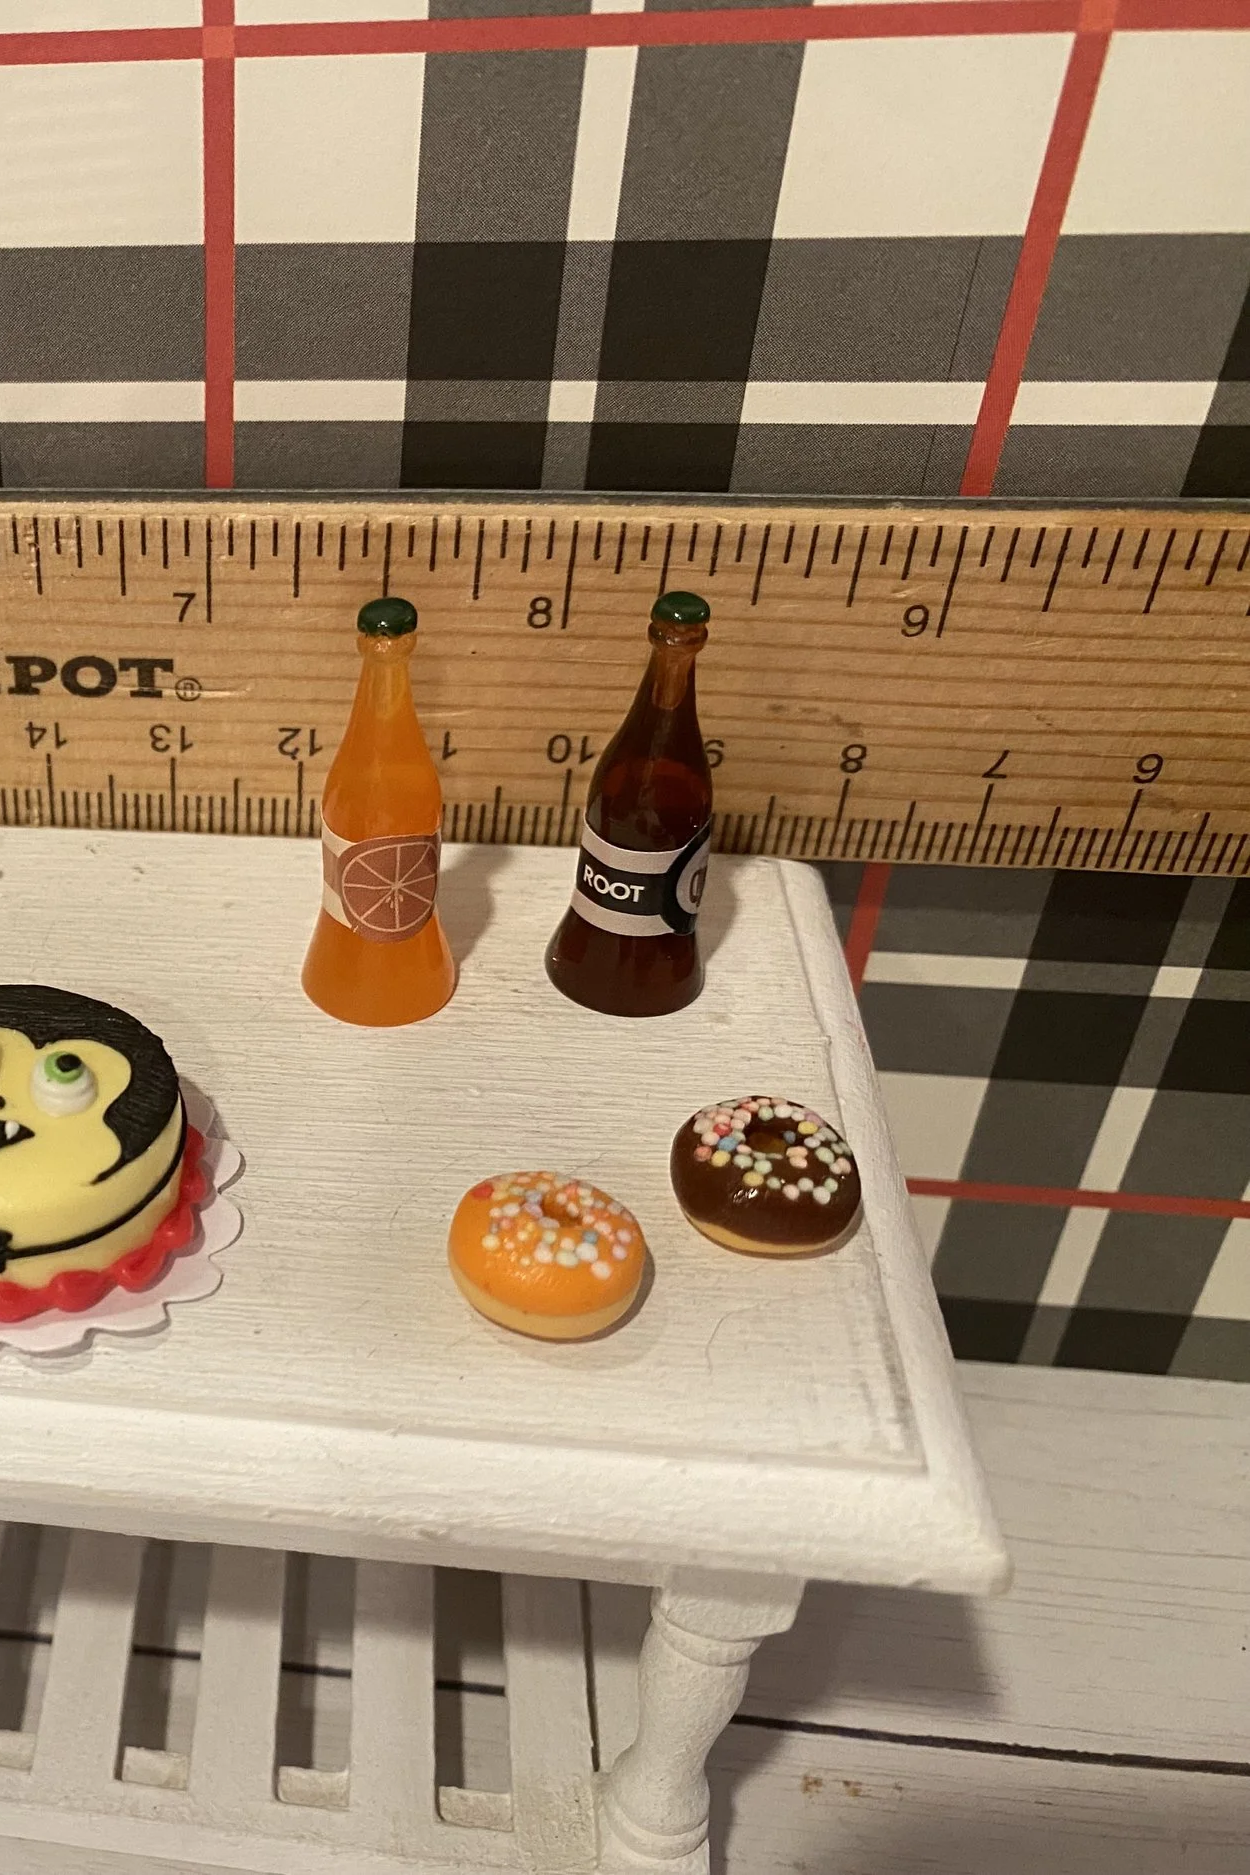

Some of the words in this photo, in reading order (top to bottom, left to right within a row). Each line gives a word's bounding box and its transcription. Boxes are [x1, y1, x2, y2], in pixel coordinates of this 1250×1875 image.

[172, 592, 196, 622] 7
[527, 597, 552, 629] 8
[900, 604, 929, 637] 9
[25, 721, 68, 749] 14
[150, 724, 194, 753] 13
[278, 727, 323, 757] 12
[440, 731, 457, 759] 1
[547, 734, 594, 764] 10
[840, 743, 868, 774] 8
[982, 750, 1011, 780] 7
[1132, 752, 1165, 785] 6
[582, 863, 645, 904] ROOT
